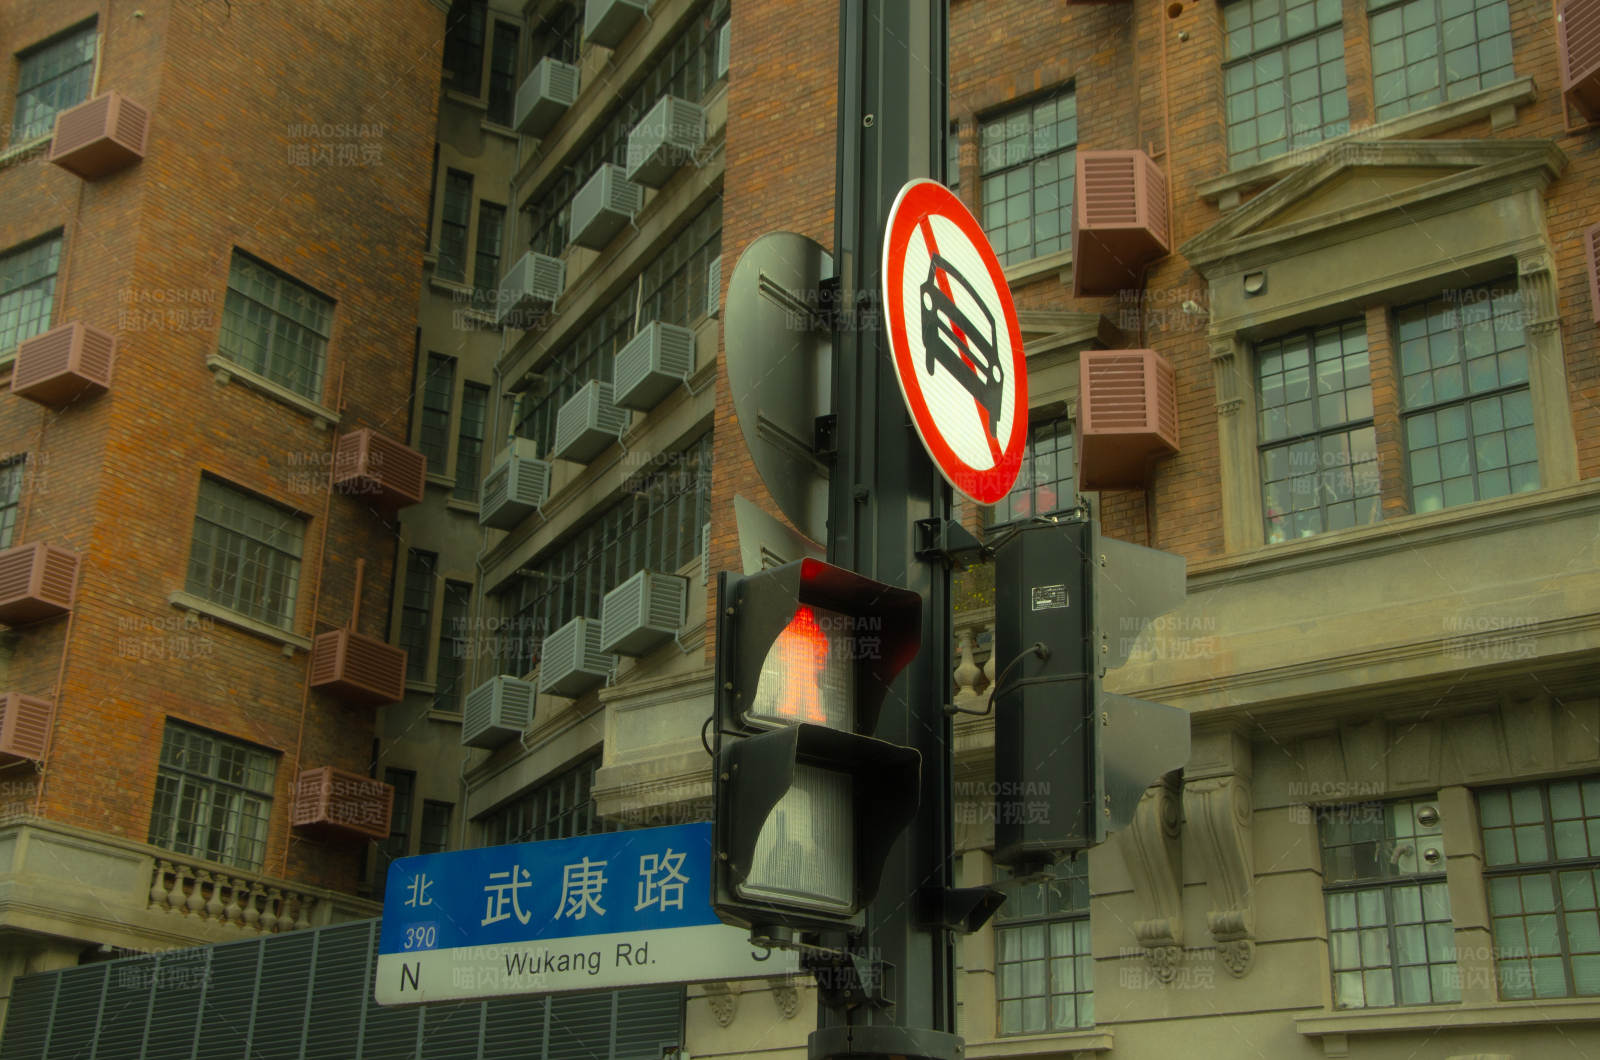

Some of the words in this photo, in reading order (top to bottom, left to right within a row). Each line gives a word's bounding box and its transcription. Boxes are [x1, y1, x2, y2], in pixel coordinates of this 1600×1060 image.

[404, 873, 434, 908] 北
[481, 848, 690, 926] 武康路
[403, 926, 436, 949] 390
[505, 950, 601, 976] Wukang
[615, 941, 656, 967] Rd.
[400, 961, 421, 992] N
